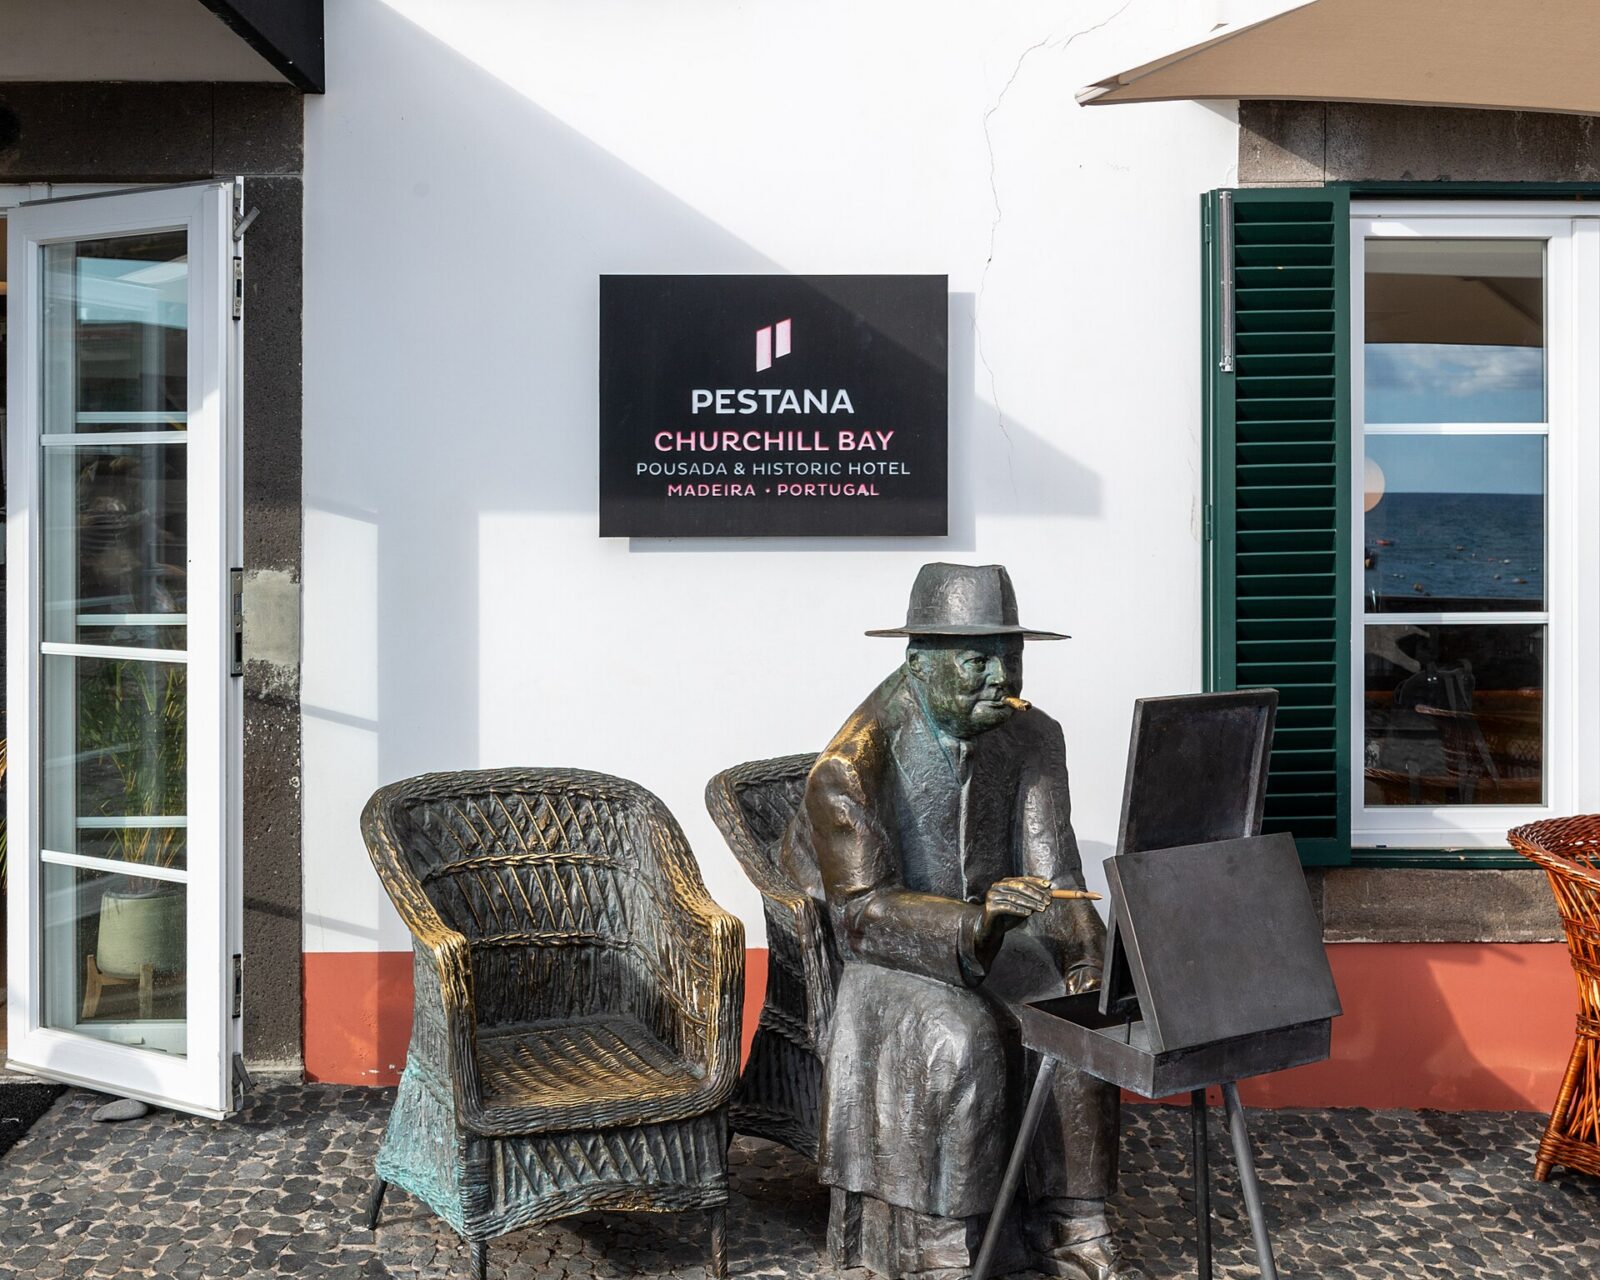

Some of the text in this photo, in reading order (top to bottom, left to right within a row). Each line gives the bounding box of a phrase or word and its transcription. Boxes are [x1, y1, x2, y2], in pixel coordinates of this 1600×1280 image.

[692, 389, 854, 414] PESTANA
[655, 431, 894, 451] CHURCHILL BAY
[637, 462, 910, 475] POUSADA & HISTORIC HOTEL
[668, 484, 755, 496] MADEIRA
[778, 484, 879, 496] PORTUGAL
